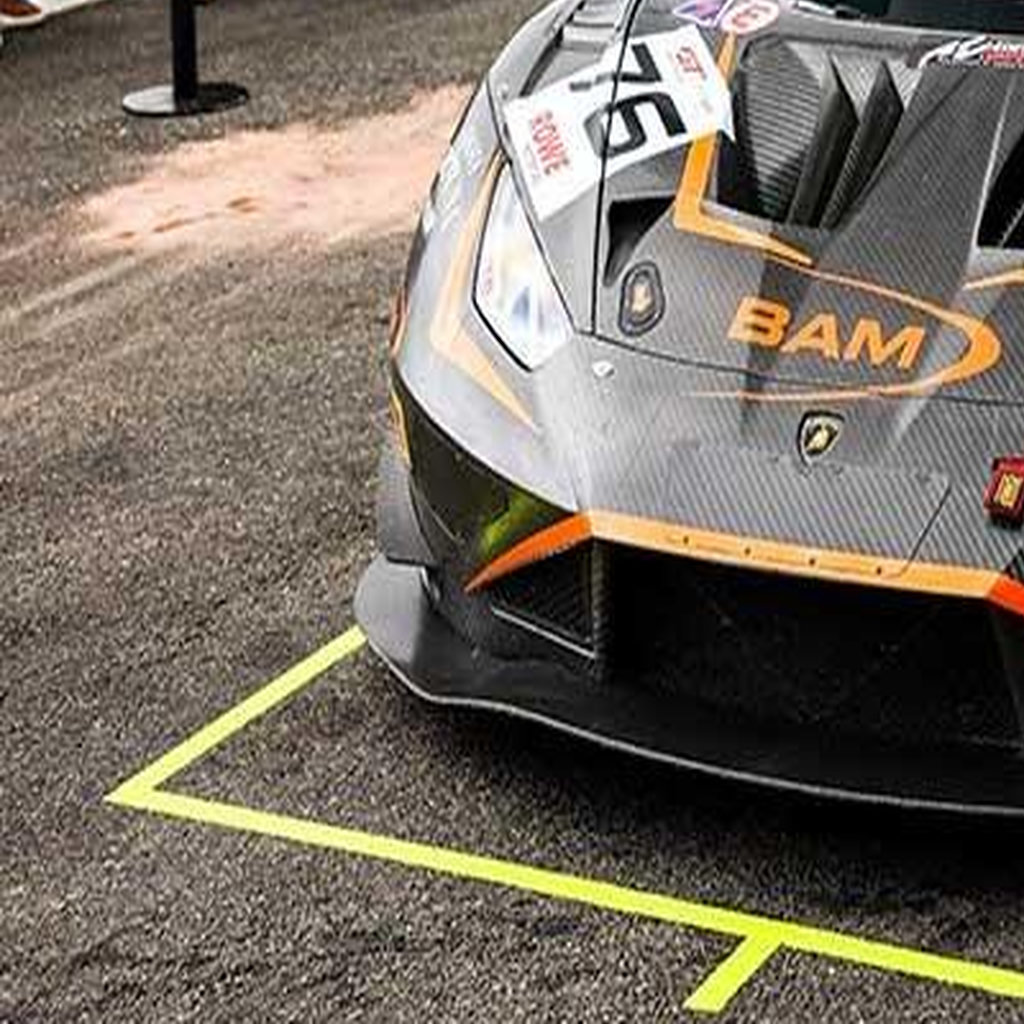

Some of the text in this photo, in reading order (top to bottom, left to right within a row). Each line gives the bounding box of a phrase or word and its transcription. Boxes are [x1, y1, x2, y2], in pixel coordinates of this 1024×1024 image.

[569, 42, 688, 159] 76
[531, 110, 571, 176] ROWE
[727, 295, 926, 369] BAM
